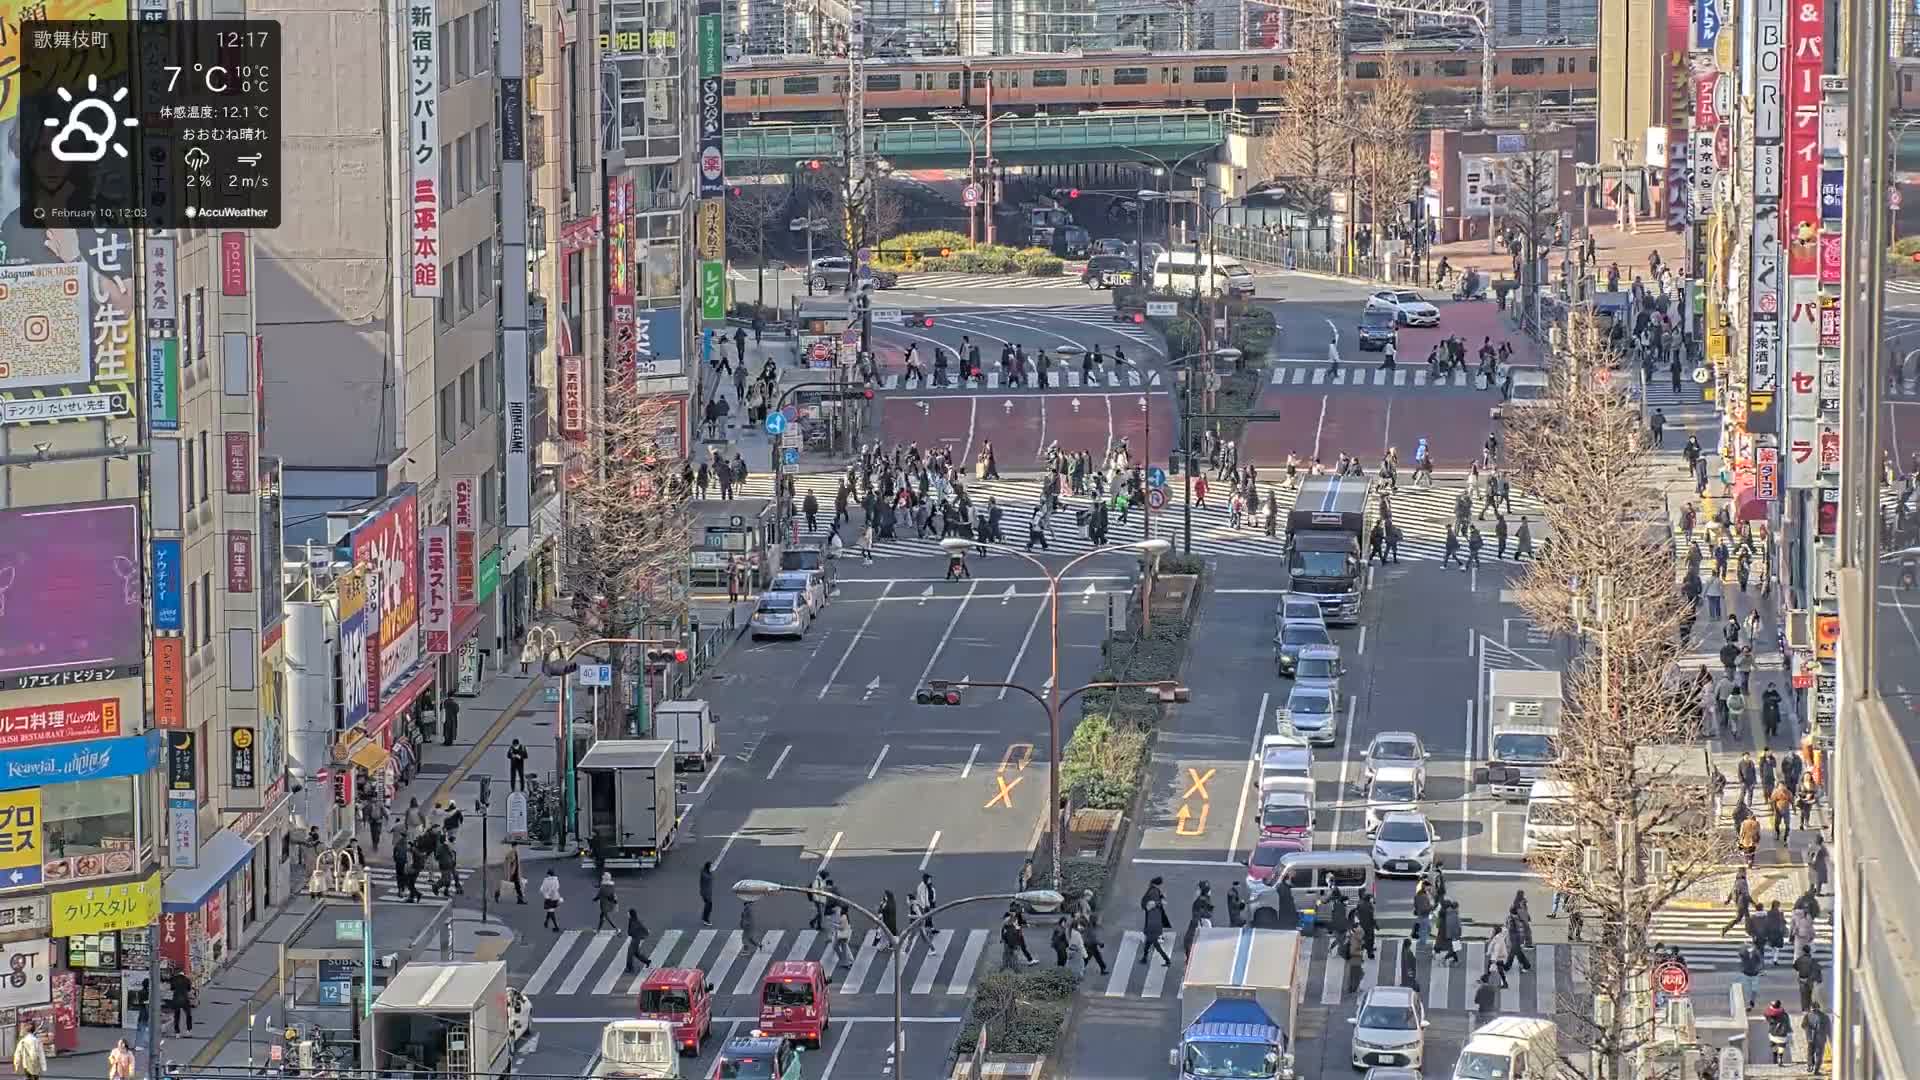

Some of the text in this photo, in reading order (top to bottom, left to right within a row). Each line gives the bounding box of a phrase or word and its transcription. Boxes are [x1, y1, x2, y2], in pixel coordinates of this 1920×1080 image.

[411, 6, 434, 164] 新宿サンパーク
[414, 179, 436, 286] 三平本館
[706, 269, 719, 308] レイク
[1755, 324, 1768, 376] 大衆酒場
[152, 348, 163, 409] FamilyMart
[1791, 303, 1816, 464] パセラ
[49, 399, 106, 414] たいせい先生
[509, 401, 524, 454] HOMEGAME
[456, 482, 467, 525] GAME
[429, 536, 444, 623] 三平ストア
[18, 669, 116, 688] リアエイドビジョン
[20, 730, 65, 743] RESTAURANT
[65, 897, 137, 921] クリスタル
